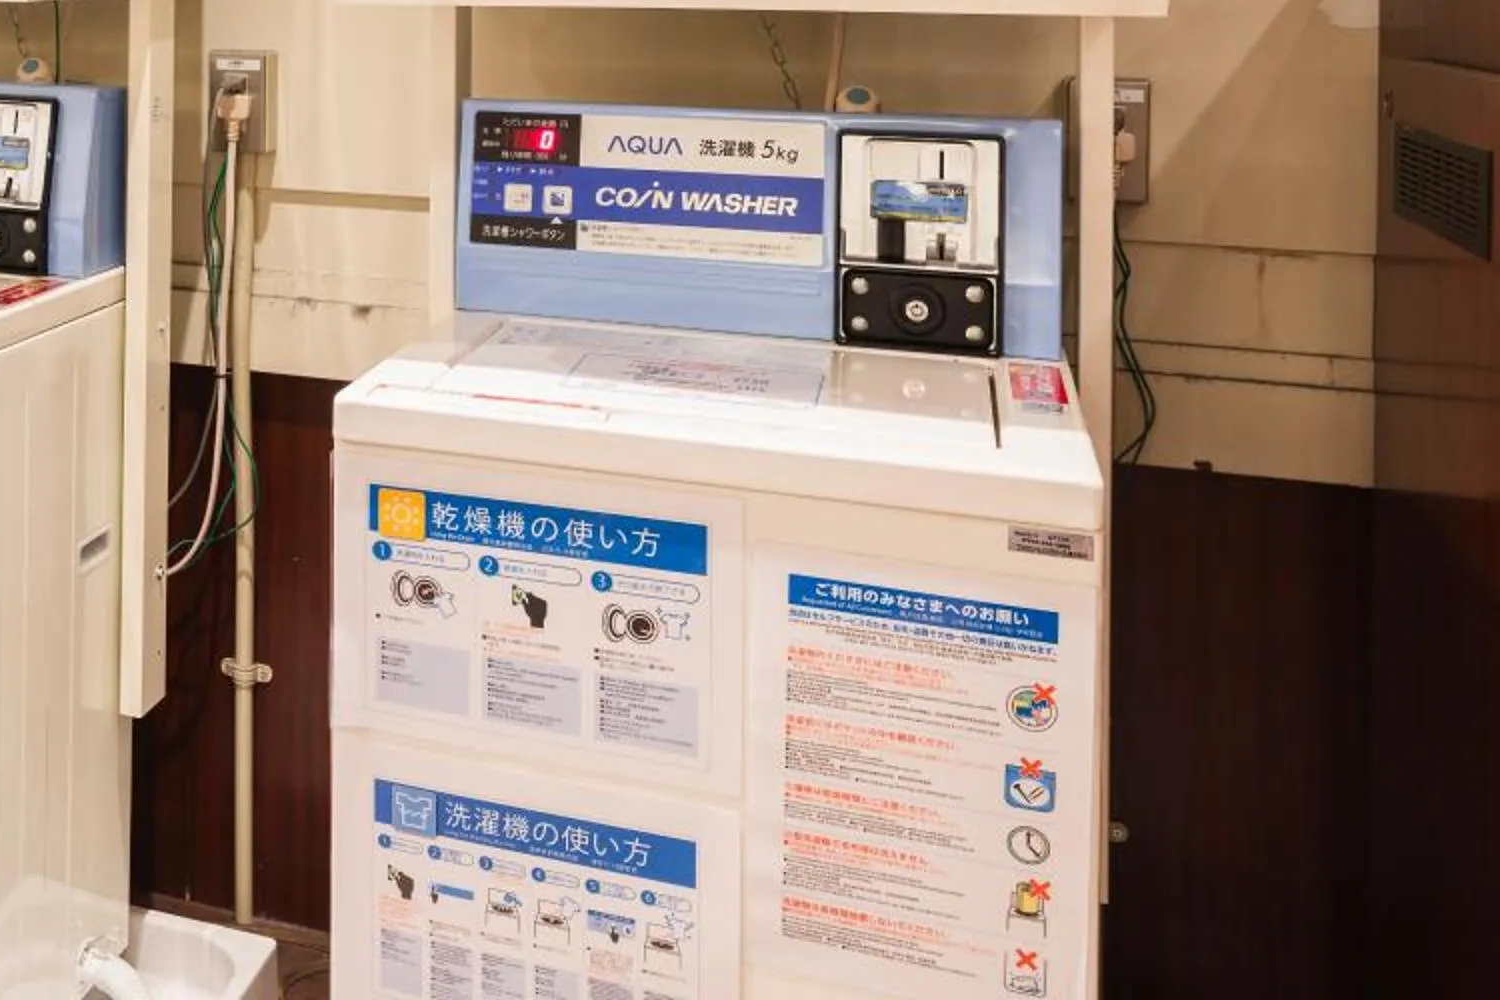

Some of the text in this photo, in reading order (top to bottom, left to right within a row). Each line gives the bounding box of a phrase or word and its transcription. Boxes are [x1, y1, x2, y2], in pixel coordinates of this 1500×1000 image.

[539, 129, 555, 150] 0
[607, 134, 683, 157] AQUA
[699, 138, 799, 164] 洗濯機 5kg
[680, 190, 799, 217] WASHER
[431, 501, 662, 558] 乾燥機の使い方
[484, 560, 494, 573] 2
[597, 575, 607, 589] 3
[814, 583, 1029, 626] ご利用のみなさまへのお願い
[444, 801, 652, 868] 洗濯機の使い方
